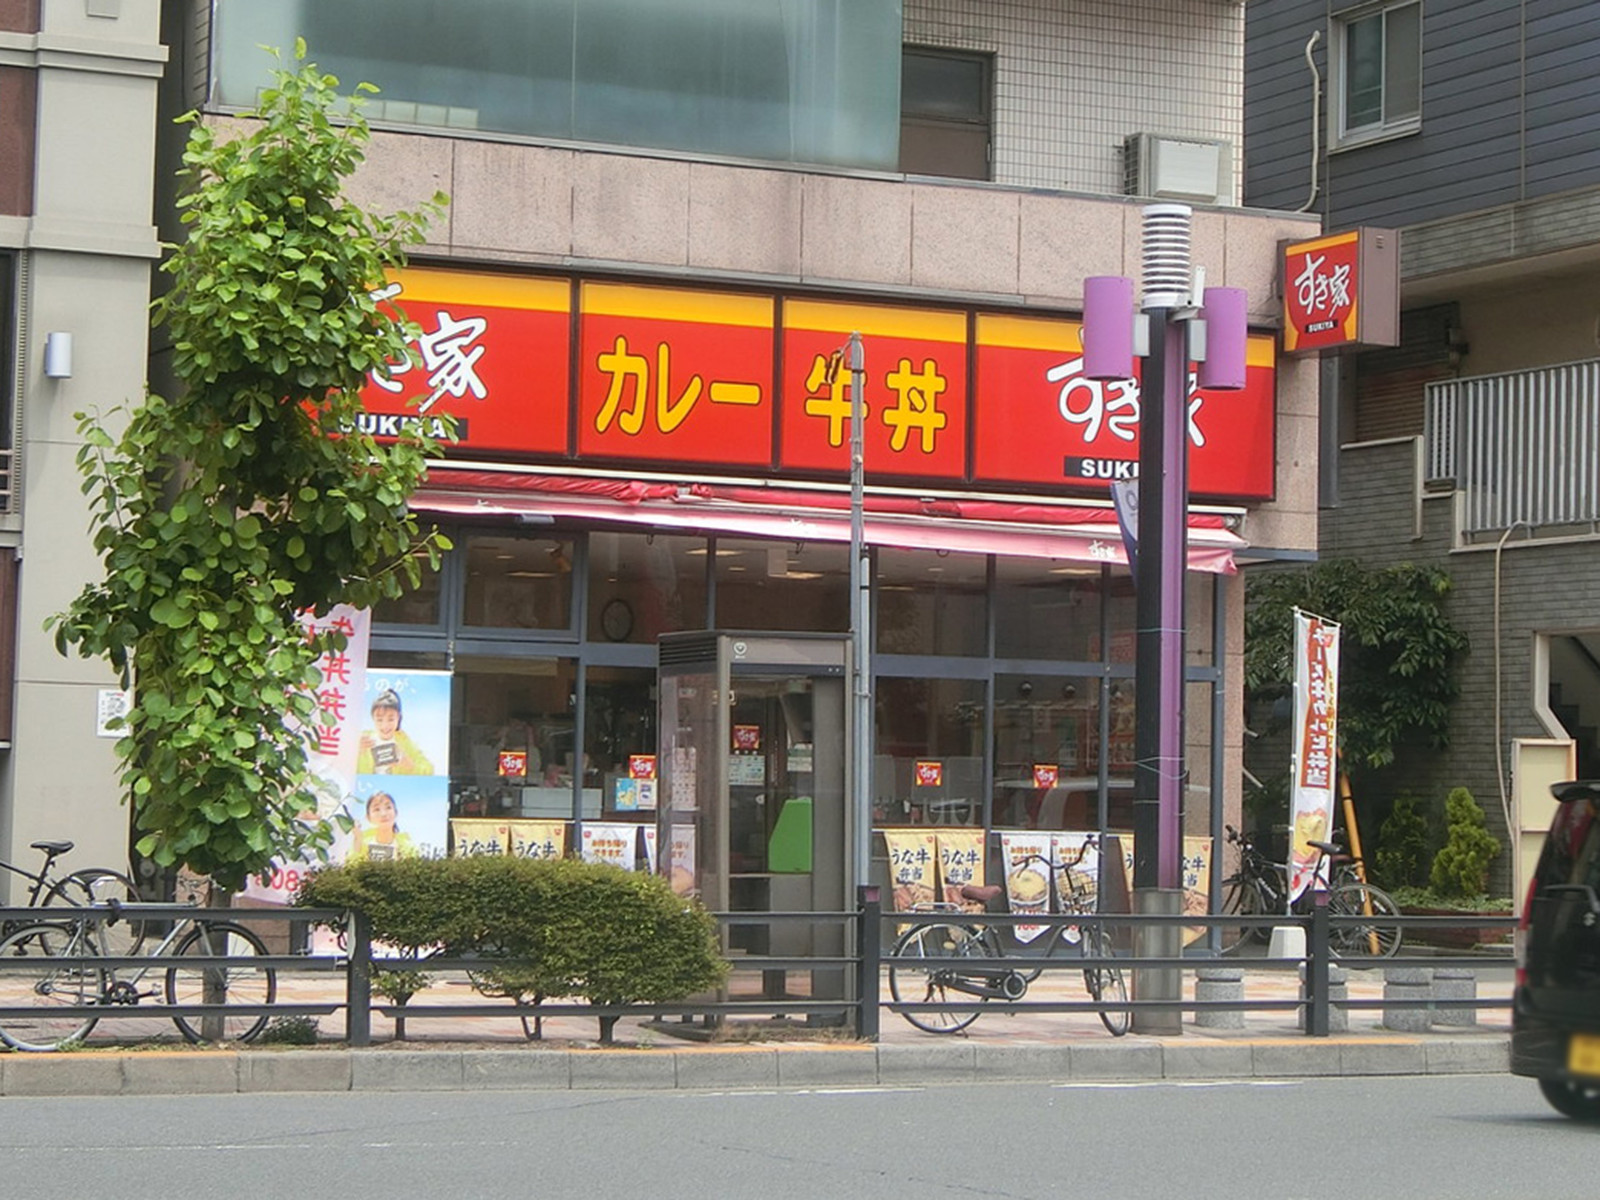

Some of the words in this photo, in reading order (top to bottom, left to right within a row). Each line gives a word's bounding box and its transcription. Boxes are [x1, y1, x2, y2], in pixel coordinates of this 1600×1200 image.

[1294, 252, 1350, 318] すき家
[595, 335, 761, 435] カレー
[1047, 327, 1206, 447] すき
[804, 351, 947, 453] 牛丼
[459, 839, 502, 857] うな牛
[515, 840, 557, 859] うな牛
[892, 847, 931, 865] うな牛
[942, 848, 981, 866] うな牛
[899, 866, 923, 880] 弁当
[949, 867, 973, 881] 弁当
